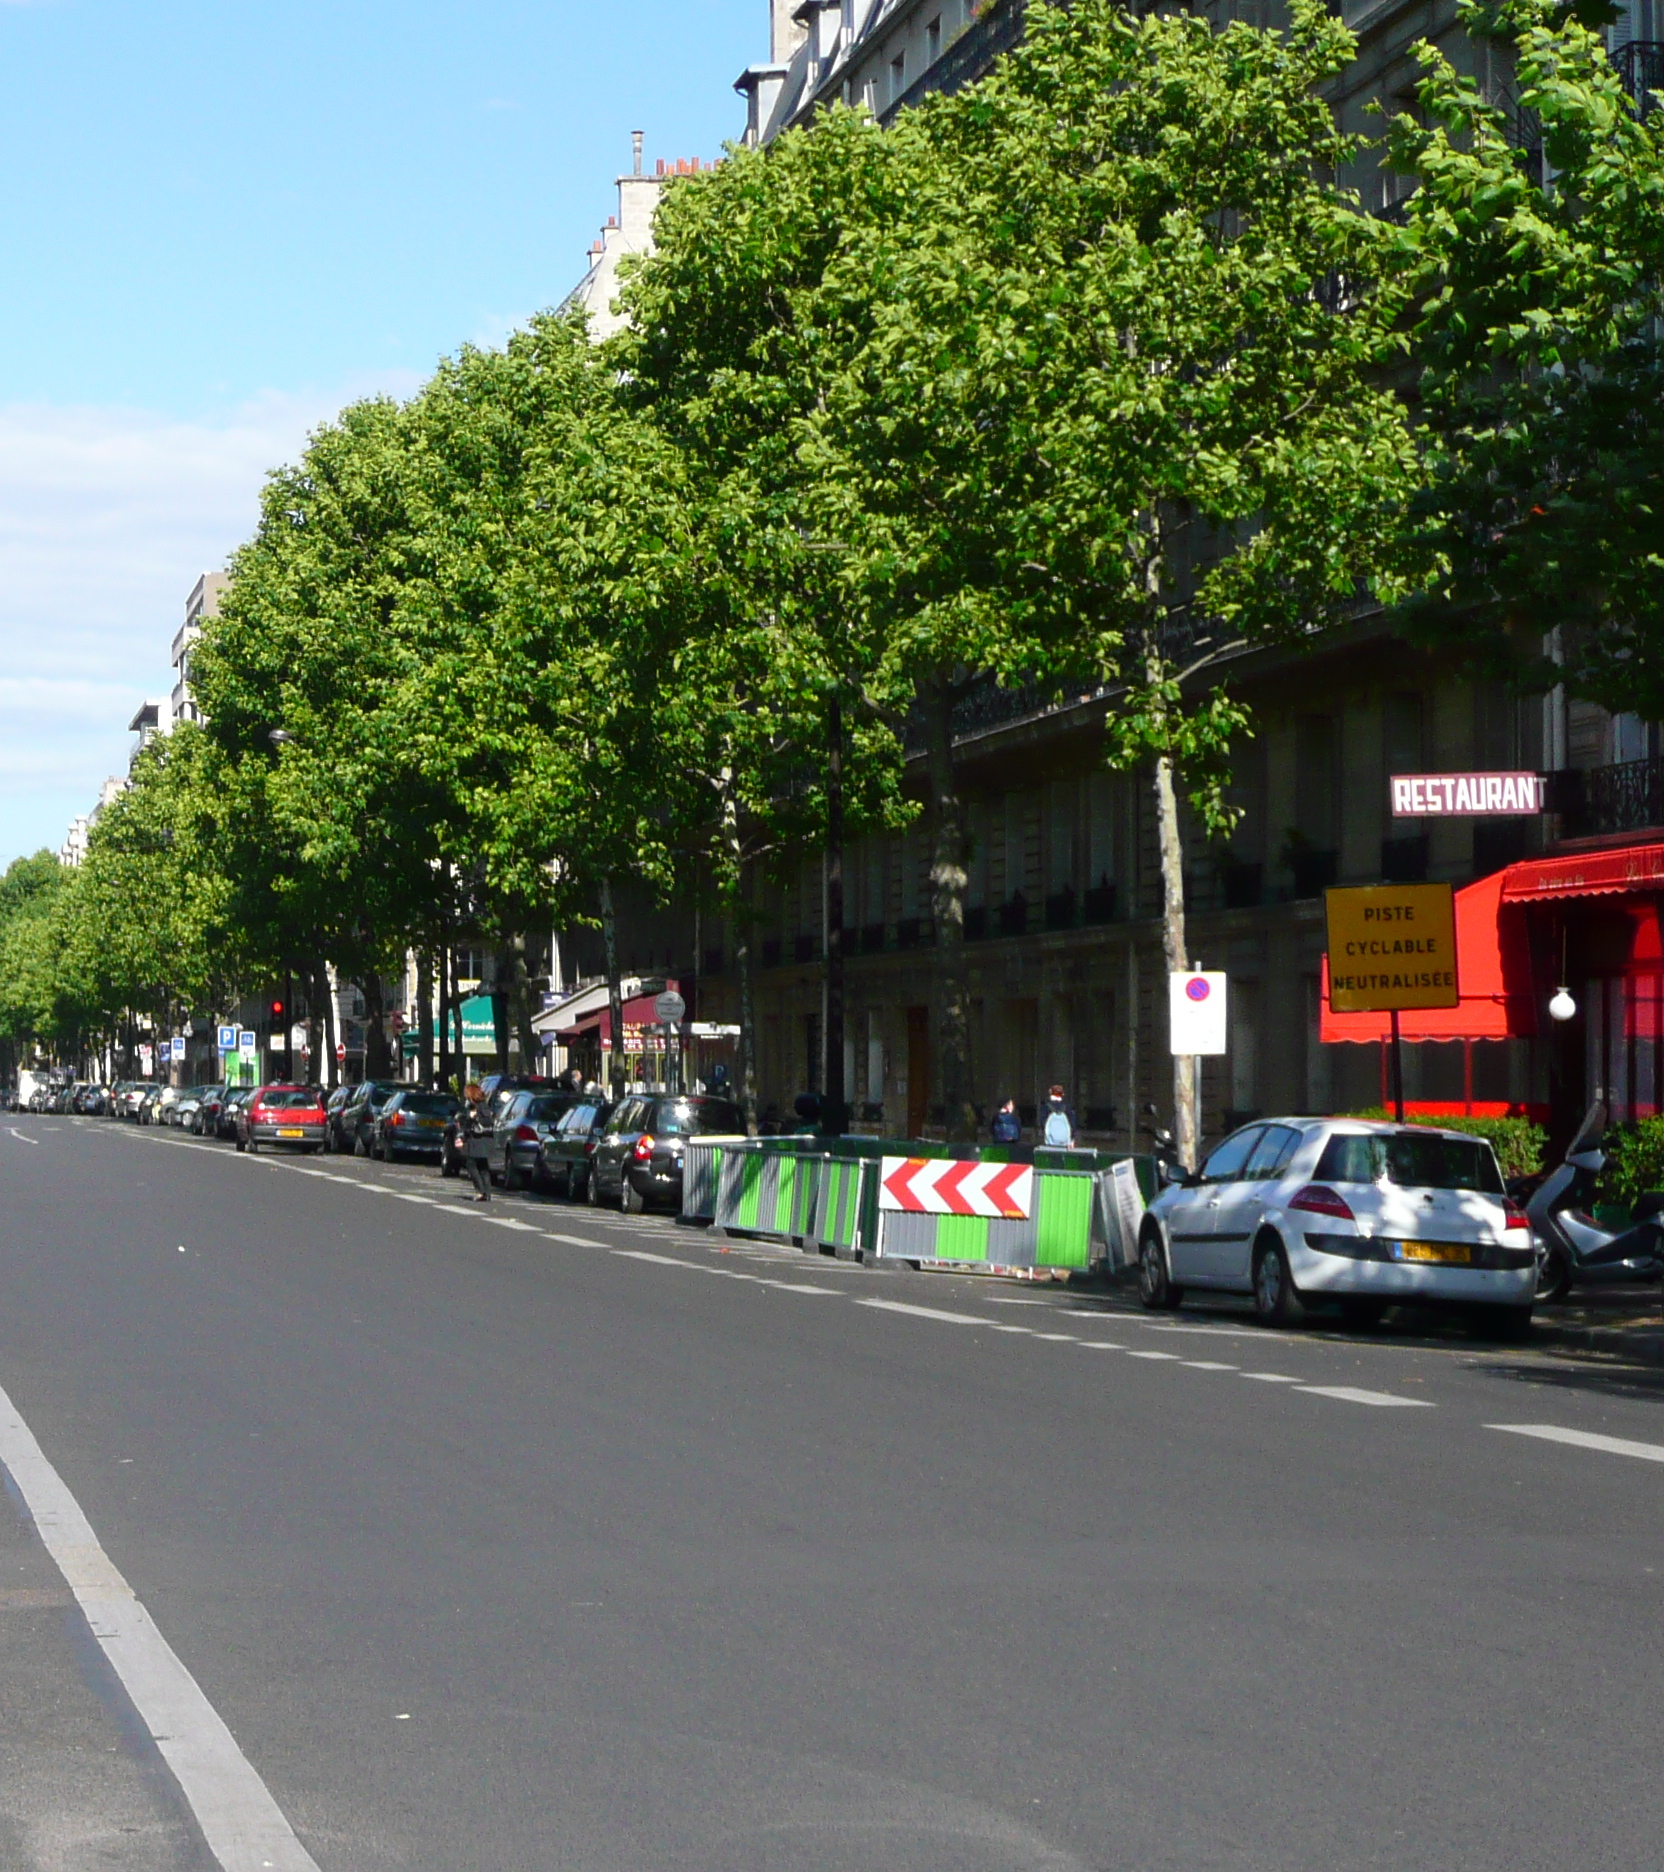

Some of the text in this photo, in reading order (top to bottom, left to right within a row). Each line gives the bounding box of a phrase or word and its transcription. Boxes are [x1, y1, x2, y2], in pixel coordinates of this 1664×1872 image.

[1394, 775, 1547, 812] RESTAURANT
[1364, 906, 1415, 922] PISTE
[1345, 937, 1437, 956] CYCLABLE
[1333, 969, 1455, 991] NEUTRALISÉE
